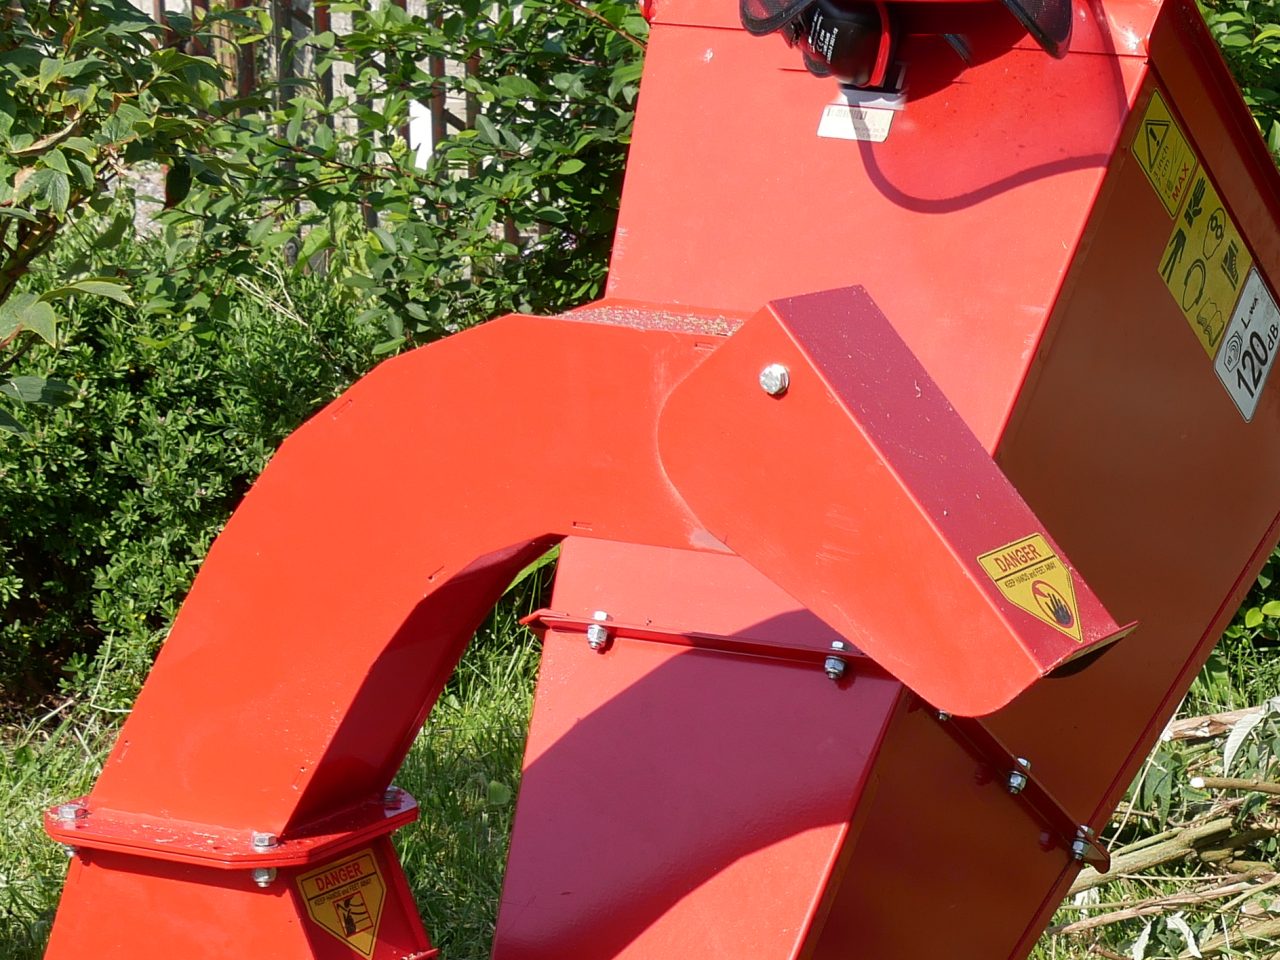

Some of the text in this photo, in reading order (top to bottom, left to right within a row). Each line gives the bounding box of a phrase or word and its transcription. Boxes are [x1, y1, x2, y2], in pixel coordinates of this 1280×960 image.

[1172, 162, 1189, 202] MAX
[994, 544, 1042, 573] DANGER
[315, 862, 363, 892] DANGER
